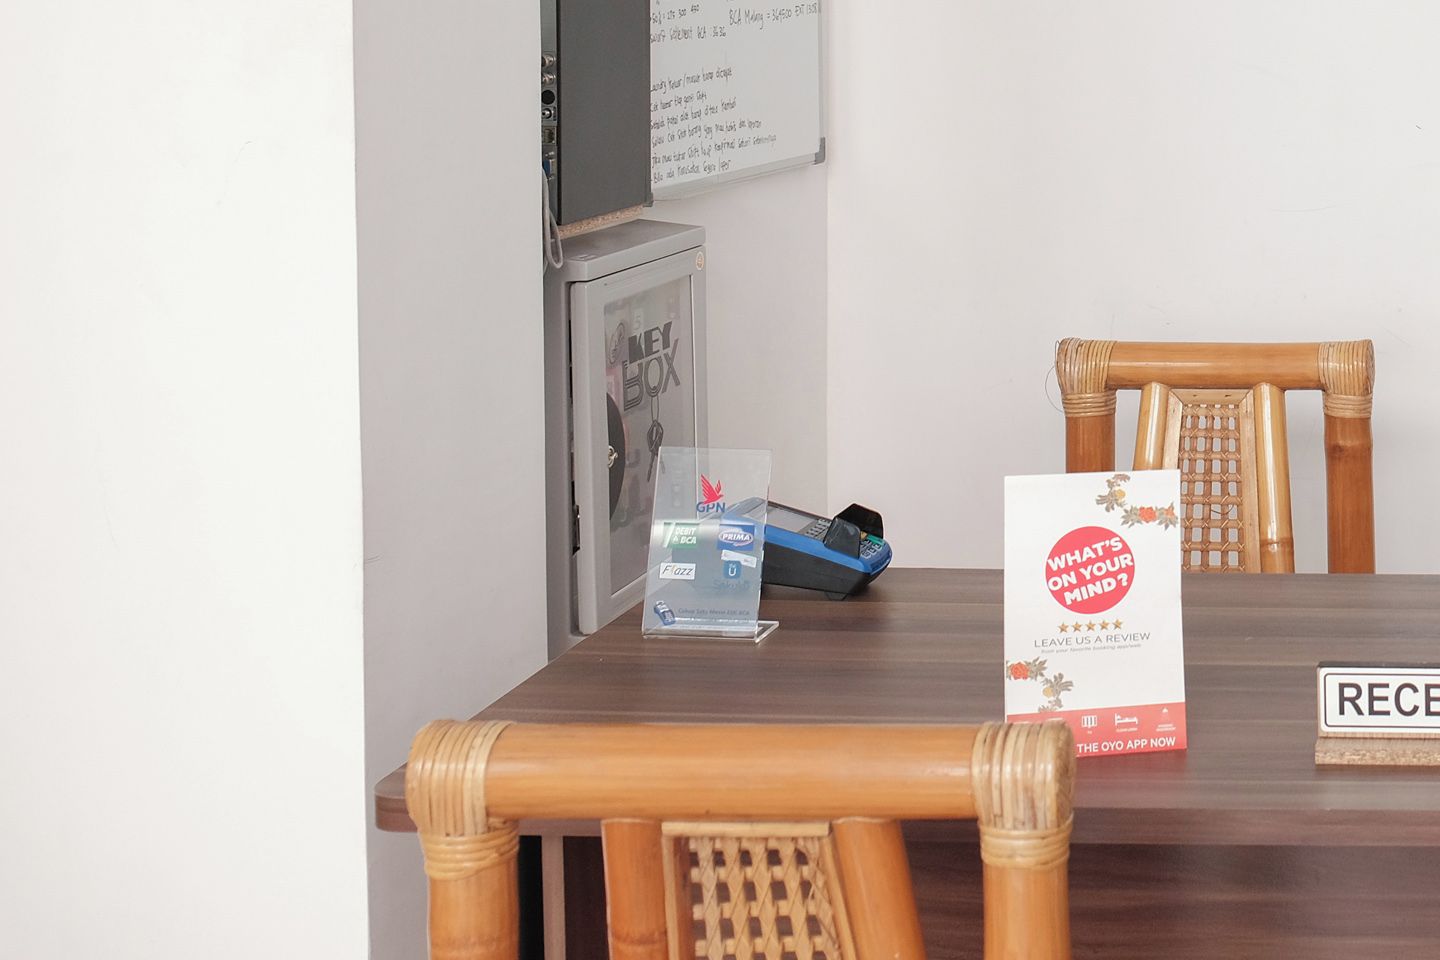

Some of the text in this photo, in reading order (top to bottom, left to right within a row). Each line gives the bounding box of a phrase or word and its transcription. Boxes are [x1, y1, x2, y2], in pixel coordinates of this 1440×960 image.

[628, 321, 672, 364] KEY
[622, 338, 681, 411] BOX
[696, 501, 726, 513] GPN
[675, 527, 696, 536] DEBIT
[722, 533, 751, 541] PRIMA
[680, 536, 697, 545] BCA
[1047, 537, 1123, 572] WHAT'S
[662, 565, 694, 576] Flazz
[1048, 553, 1133, 591] ON YOUR
[1064, 573, 1128, 606] MIND?
[1034, 632, 1151, 648] LEAVE US A REVIEW
[1077, 736, 1176, 753] THE OYO APP NOW
